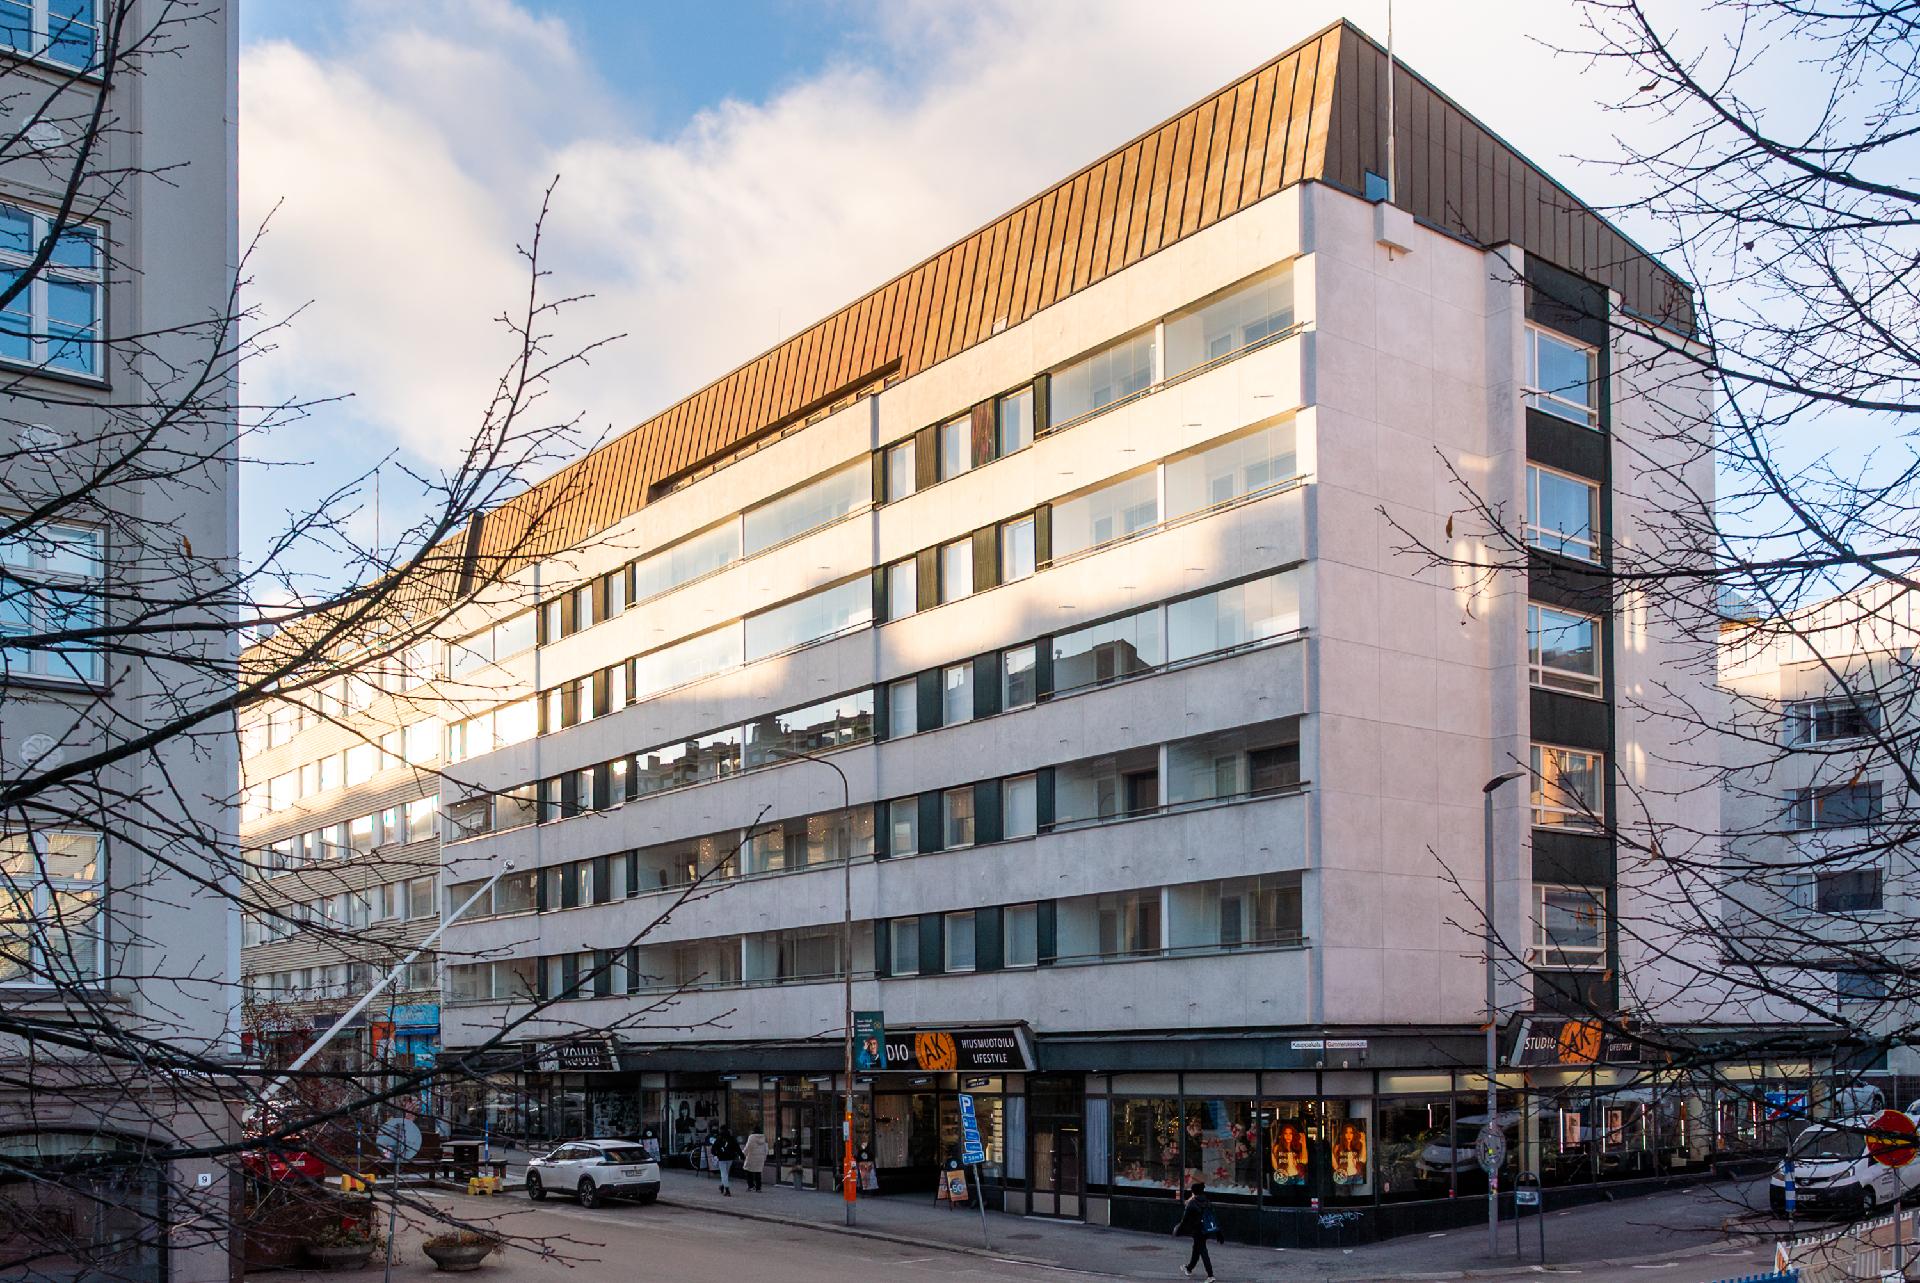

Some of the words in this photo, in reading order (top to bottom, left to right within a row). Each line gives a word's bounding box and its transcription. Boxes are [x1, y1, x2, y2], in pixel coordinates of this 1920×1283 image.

[1524, 1037, 1556, 1050] STUDIO
[886, 1044, 909, 1061] DIO
[972, 1053, 1008, 1064] LIFESTYLE
[961, 1096, 972, 1113] P
